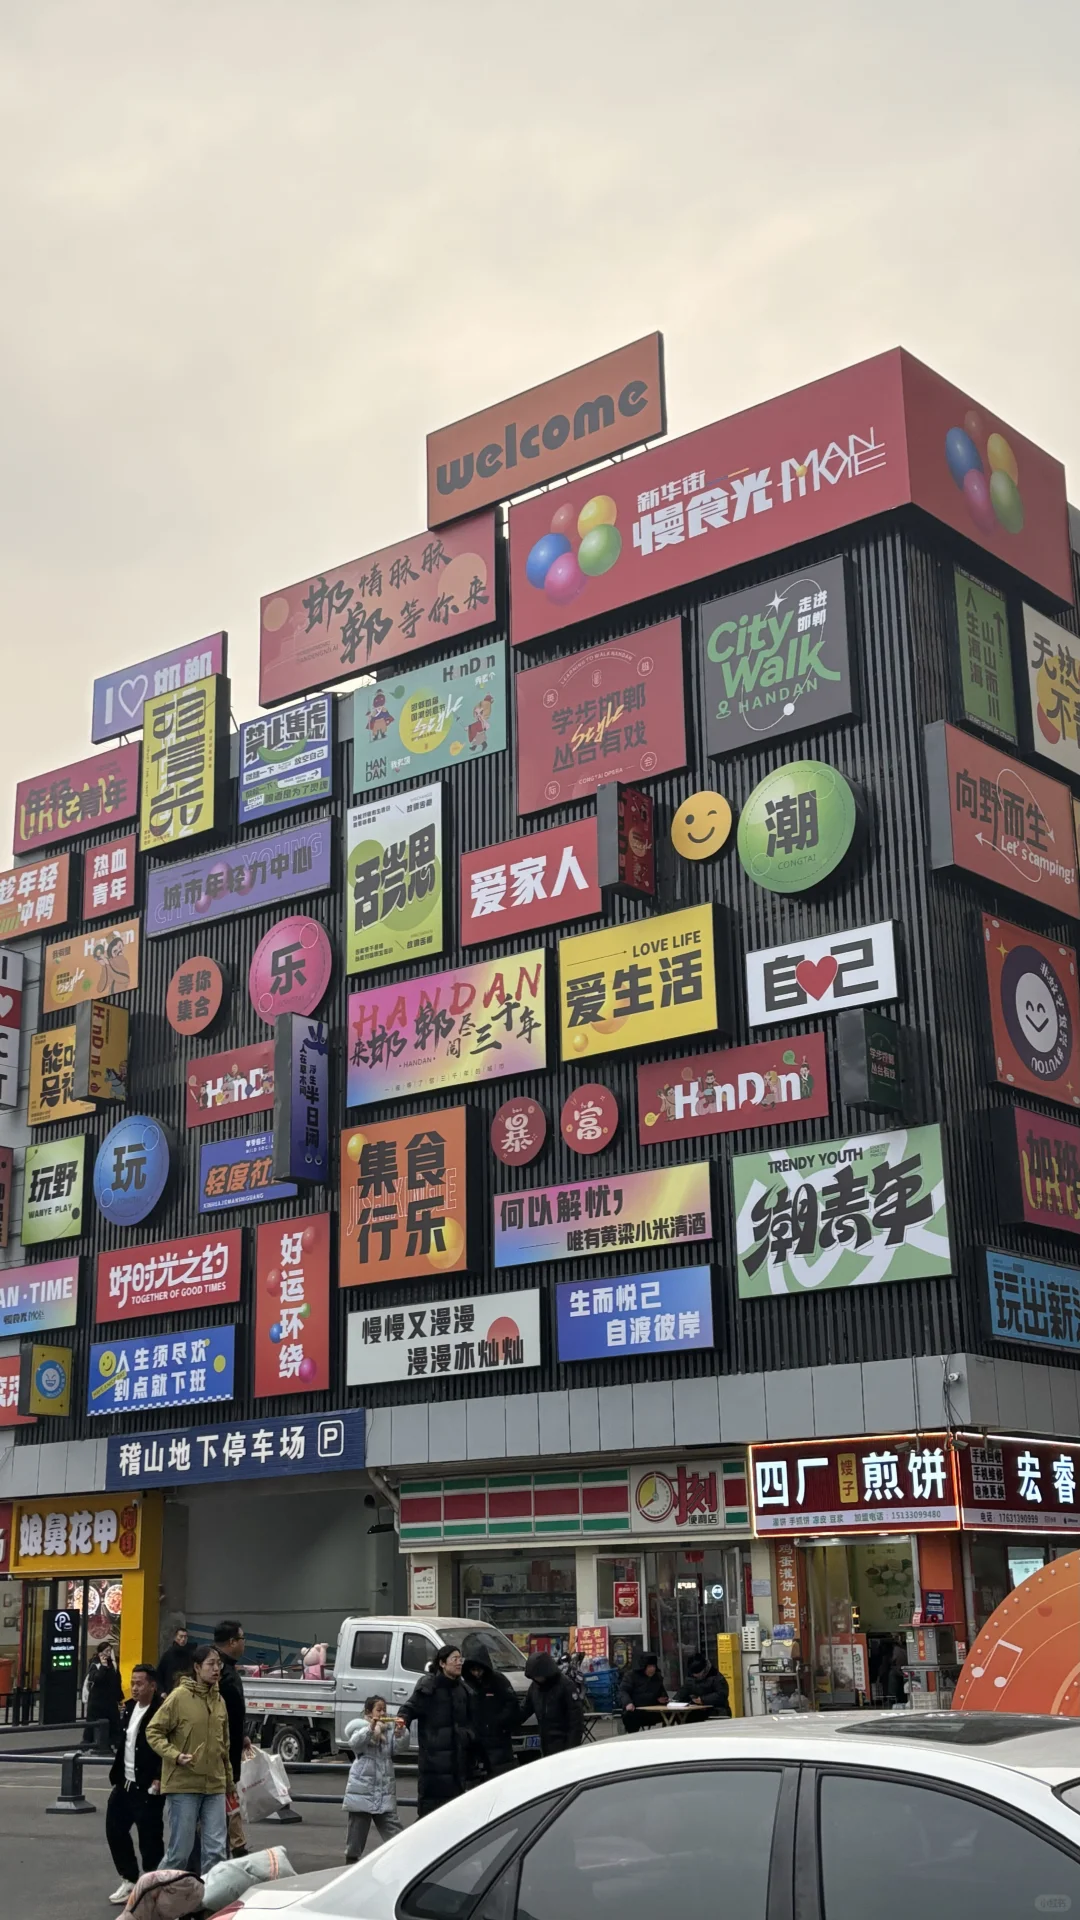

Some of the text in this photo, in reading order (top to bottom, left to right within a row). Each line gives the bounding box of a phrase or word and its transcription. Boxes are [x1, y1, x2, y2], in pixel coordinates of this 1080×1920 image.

[436, 380, 648, 496] welcome
[632, 466, 772, 556] 慢食光
[638, 470, 705, 513] 新华街
[798, 590, 828, 614] 走进
[798, 609, 826, 632] 邯郸
[707, 610, 794, 662] City
[721, 634, 841, 698] Walk
[981, 621, 1000, 721] 山山而川
[105, 687, 113, 724] I
[552, 682, 646, 735] 学步邯郸
[738, 678, 818, 714] HANDAN
[244, 700, 326, 767] 禁止焦虑
[1046, 688, 1080, 750] 不
[366, 756, 386, 771] HAN
[552, 720, 648, 773] 丛台有戏
[366, 767, 386, 782] DAN
[765, 790, 819, 858] 潮
[956, 768, 1048, 852] 向野而生
[93, 848, 127, 879] 热血
[242, 833, 322, 870] YOUNG
[777, 854, 817, 870] CONGTAI
[1029, 849, 1075, 885] camping!
[0, 862, 59, 906] 趁年轻
[92, 876, 126, 908] 青年
[163, 846, 312, 911] 城市年轻力中心
[471, 846, 588, 918] 爱家人
[18, 893, 55, 927] 冲鸭
[633, 931, 701, 958] LOVE LIFE
[178, 970, 211, 995] 等你
[270, 942, 307, 995] 乐
[177, 996, 210, 1021] 集合
[353, 964, 542, 1037] HANDAN
[567, 950, 702, 1029] 爱生活
[403, 1057, 432, 1068] HANDAN
[501, 1113, 533, 1153] 暴
[574, 1101, 602, 1140] 富
[28, 1160, 78, 1203] 玩野
[111, 1143, 147, 1192] 玩
[205, 1155, 275, 1196] 轻度社
[357, 1131, 447, 1199] 集食
[768, 1155, 815, 1174] TRENDY
[818, 1148, 863, 1166] YOUTH
[28, 1203, 72, 1219] WANYE PLAY
[357, 1195, 447, 1264] 行乐
[742, 1153, 934, 1277] 潮青年
[567, 1213, 706, 1252] 唯有黄粱小米清酒
[30, 1277, 74, 1304] TIME
[109, 1243, 228, 1308] 好时光之约
[132, 1282, 226, 1305] TOGETHER OF GOOD TIMES
[279, 1231, 304, 1379] 好运环绕
[570, 1282, 661, 1317] 生而悦己
[362, 1304, 475, 1345] 慢慢又漫漫
[606, 1310, 701, 1347] 自渡彼岸
[115, 1339, 207, 1374] 人生须尽欢
[407, 1336, 524, 1376] 漫漫亦灿灿
[114, 1368, 207, 1402] 到点就下班
[119, 1426, 338, 1476] 稽山地下停车场 P
[756, 1458, 829, 1508] 四厂
[863, 1447, 947, 1502] 煎饼
[1017, 1451, 1076, 1503] 宏睿
[689, 1514, 717, 1525] 便利店
[789, 1516, 810, 1525] 手抓饼
[891, 1510, 941, 1520] 15133099480
[778, 1544, 796, 1592] 鸡蛋灌饼
